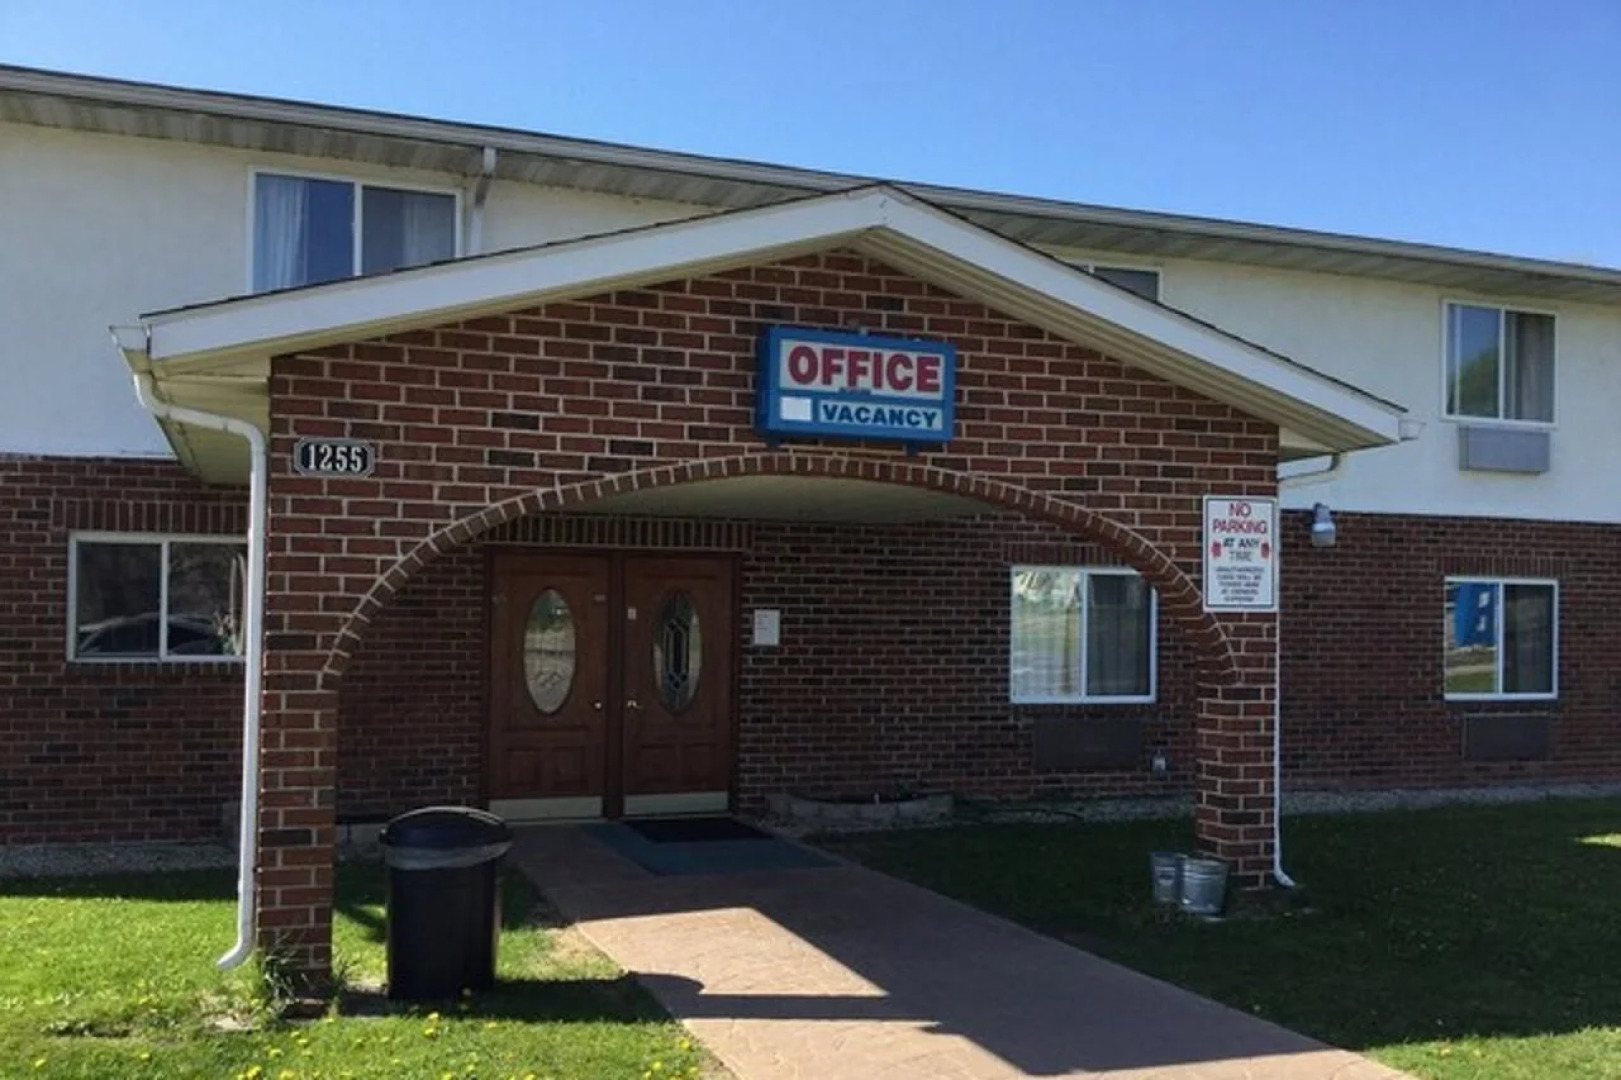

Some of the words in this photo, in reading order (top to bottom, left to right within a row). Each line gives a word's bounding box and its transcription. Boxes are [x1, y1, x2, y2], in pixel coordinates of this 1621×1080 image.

[788, 345, 941, 393] OFFICE
[822, 403, 938, 428] VACANCY
[308, 444, 362, 472] 1255
[1229, 502, 1252, 517] NO
[1213, 518, 1267, 535] PARKING
